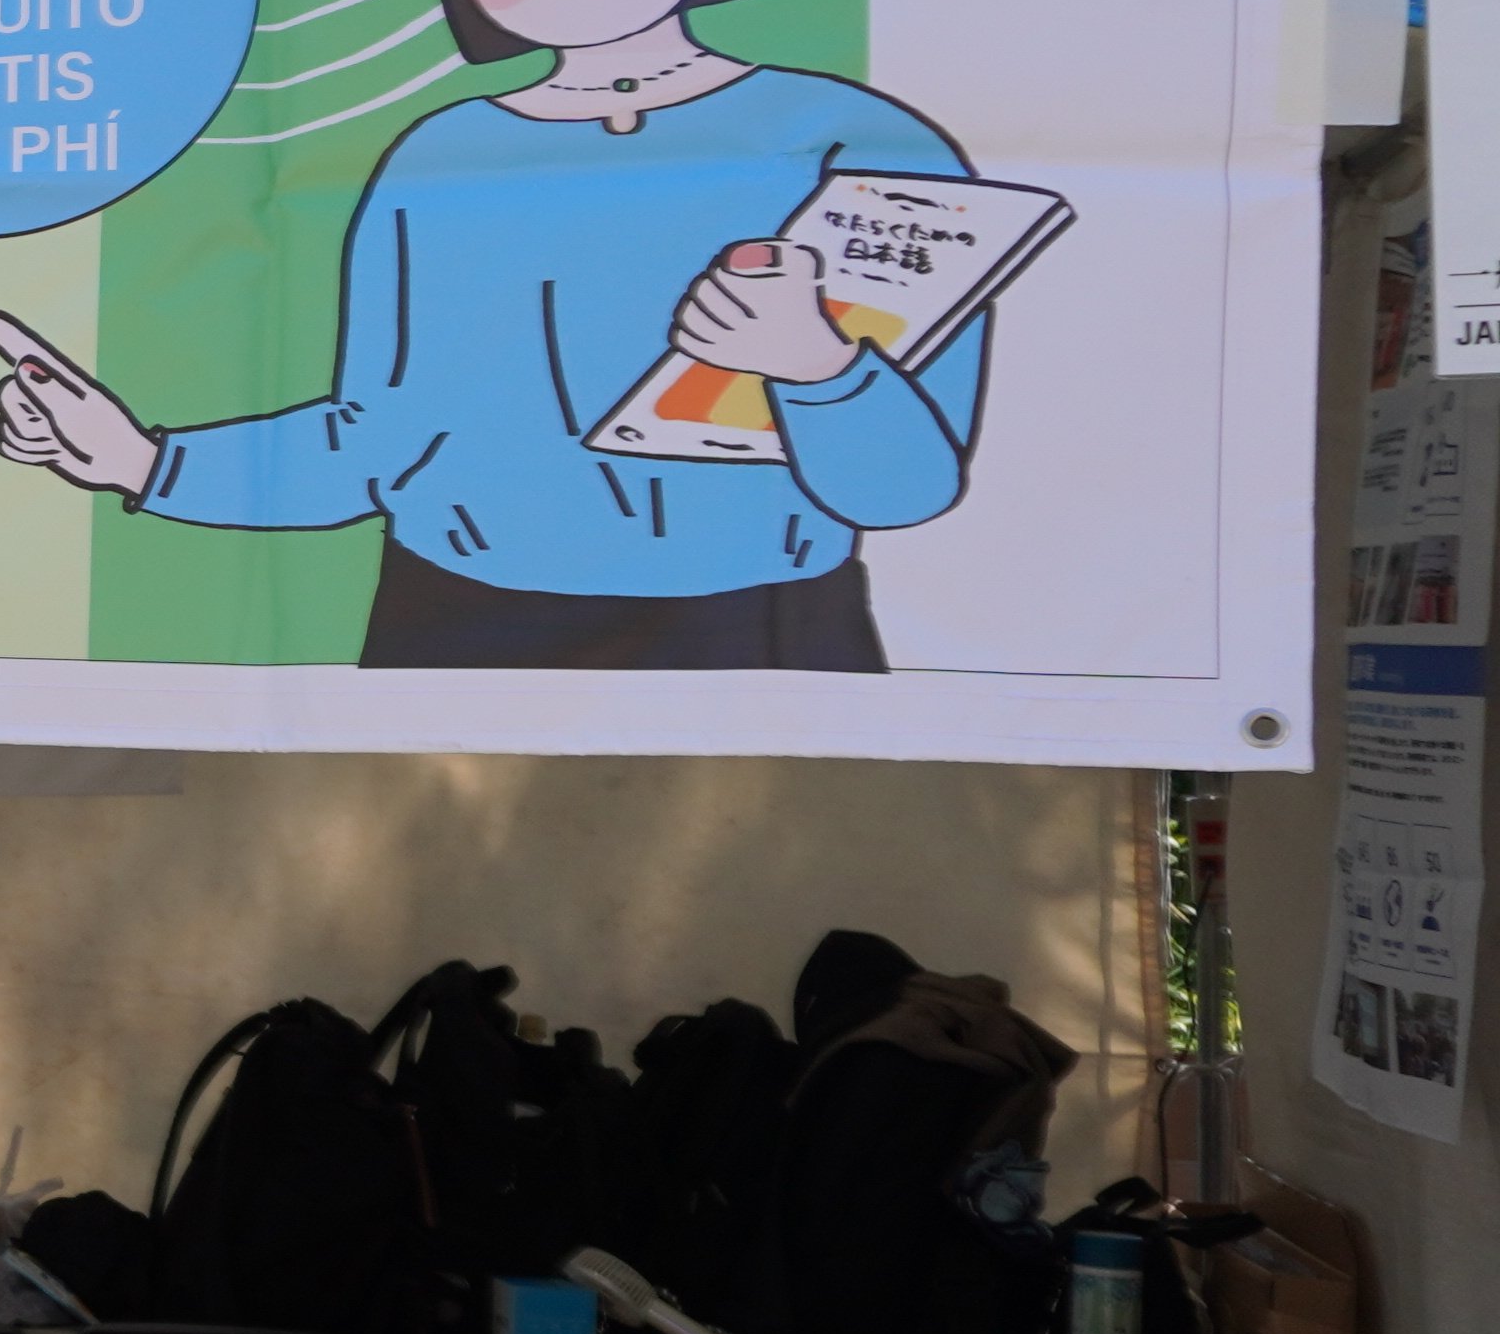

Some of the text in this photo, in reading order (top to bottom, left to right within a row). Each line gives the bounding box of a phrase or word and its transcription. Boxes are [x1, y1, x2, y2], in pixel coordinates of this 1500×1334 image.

[11, 109, 120, 173] PHÍ
[844, 237, 934, 275] 日本語
